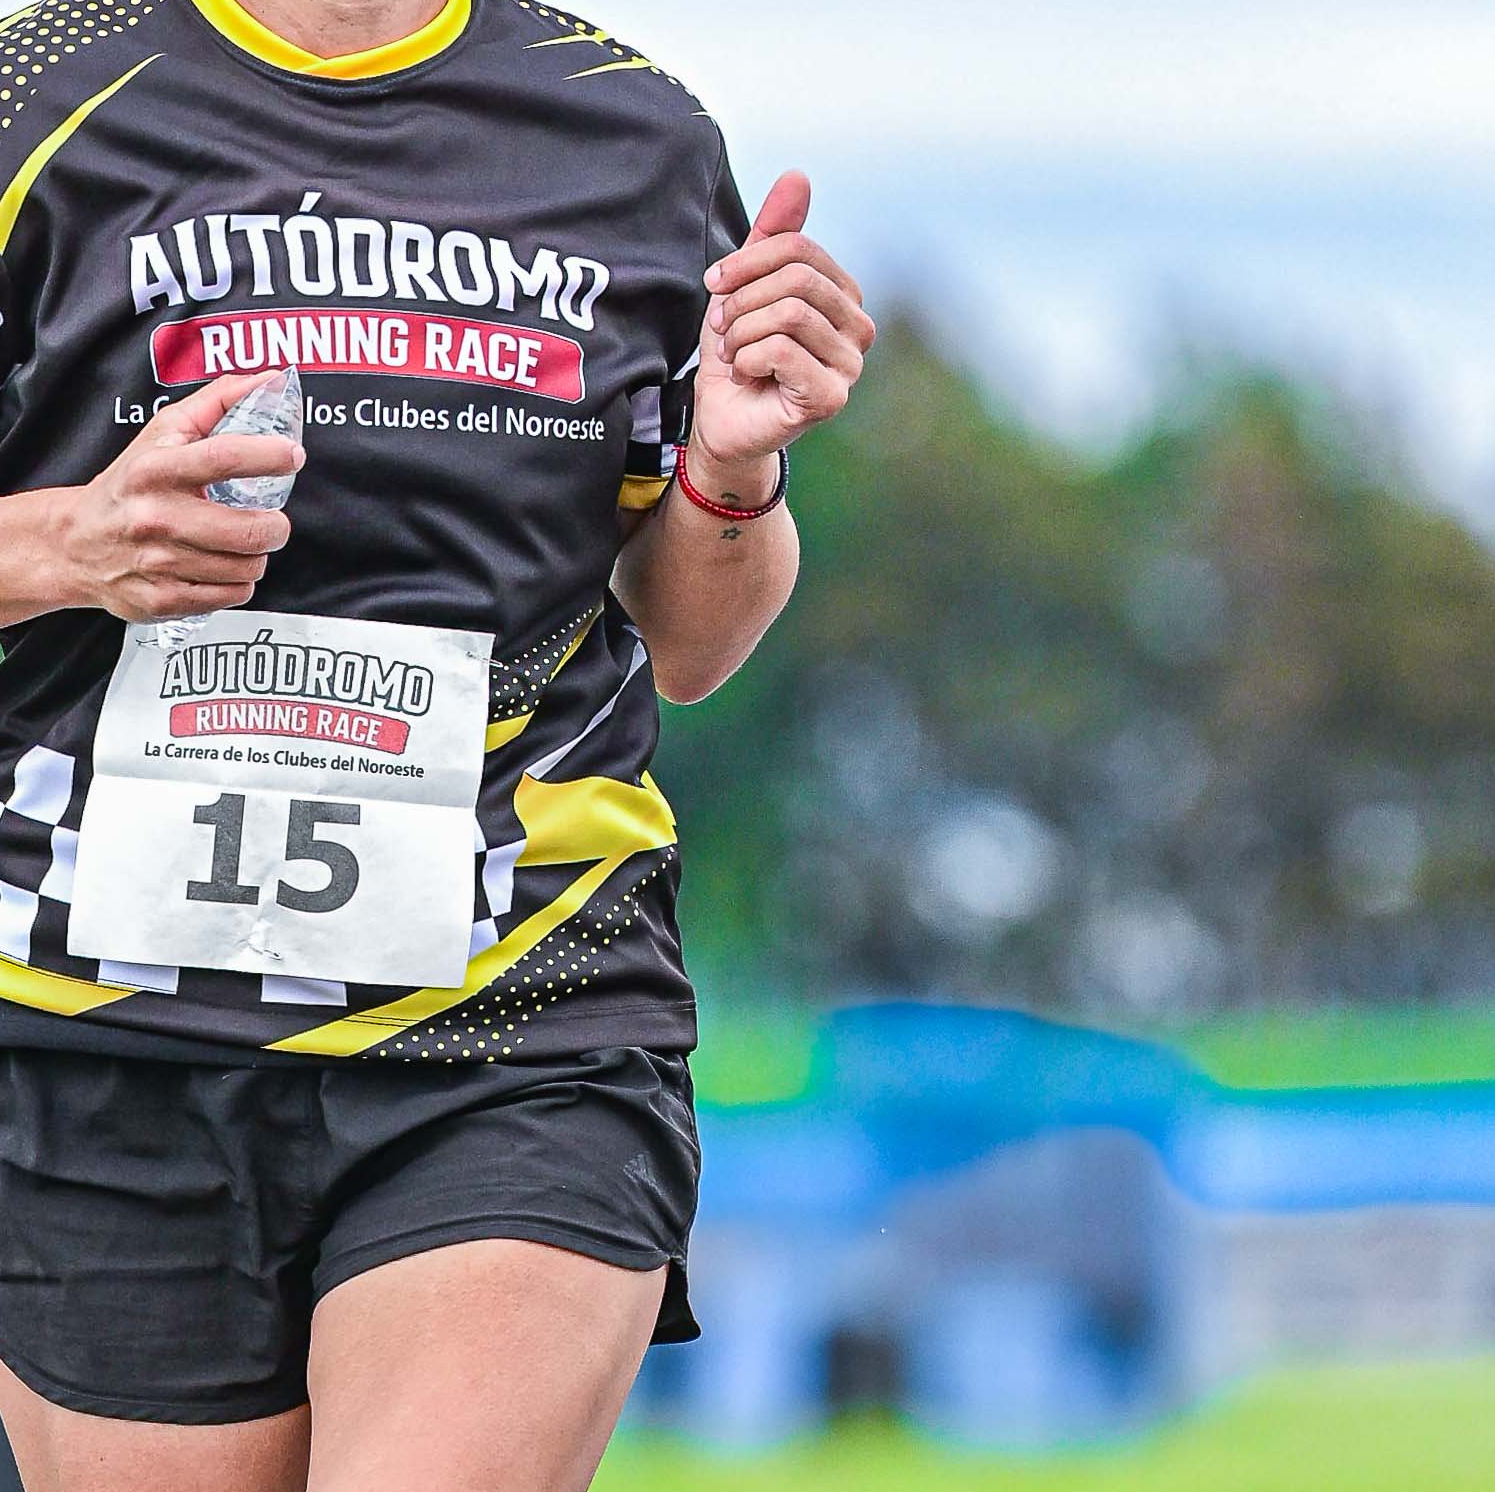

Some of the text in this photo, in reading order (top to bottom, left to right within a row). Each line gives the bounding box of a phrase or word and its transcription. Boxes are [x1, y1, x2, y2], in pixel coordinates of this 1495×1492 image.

[128, 191, 611, 332] AUTÓDROMO
[200, 314, 544, 388] RUNNING RACE
[113, 397, 145, 425] La
[306, 397, 347, 427] los
[354, 397, 449, 432] Clubes
[455, 402, 499, 435] del
[504, 407, 605, 441] Noroeste
[159, 629, 434, 717] AUTÓDROMO
[144, 742, 425, 778] La Carrera de los Clubes del Noroeste
[195, 702, 384, 746] RUNNING RACE
[185, 792, 362, 914] 15
